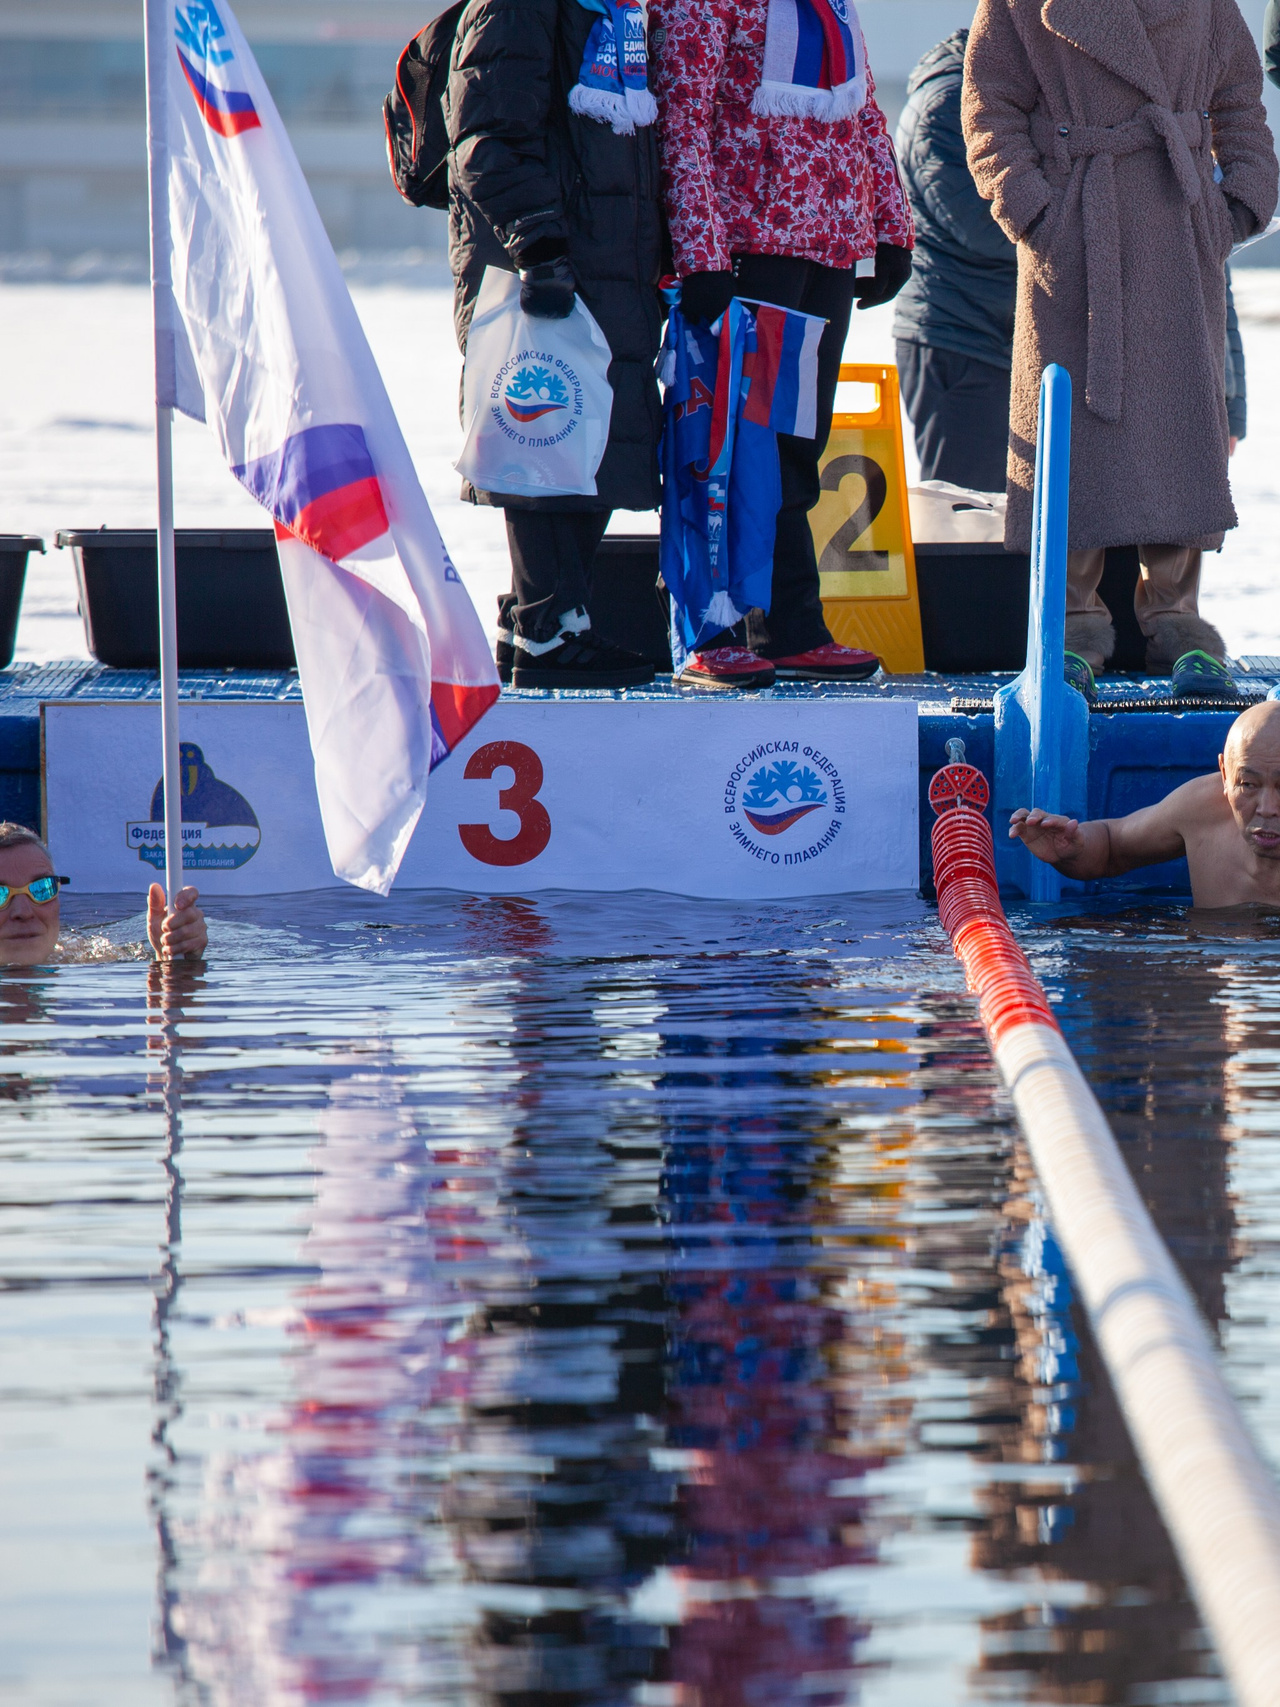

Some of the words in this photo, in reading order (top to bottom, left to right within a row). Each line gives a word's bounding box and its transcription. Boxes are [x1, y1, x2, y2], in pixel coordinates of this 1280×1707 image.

[491, 350, 554, 399] ВСЕРОССИЙСКАЯ
[555, 359, 583, 416] ФЕДЕРАЦИЯ
[491, 406, 525, 445] ЗИМНЕГО
[528, 419, 578, 447] ПЛАВАНИЯ
[818, 454, 889, 572] 2
[458, 740, 552, 867] 3
[724, 741, 799, 813] ВСЕРОССИЙСКАЯ
[802, 746, 846, 813] ФЕДЕРАЦИЯ
[131, 827, 202, 841] Федеция
[729, 821, 780, 864] ЗИМНЕГО
[784, 819, 842, 865] ПЛАВАНИЯ
[198, 859, 235, 867] ПЛАВАНИЯ
